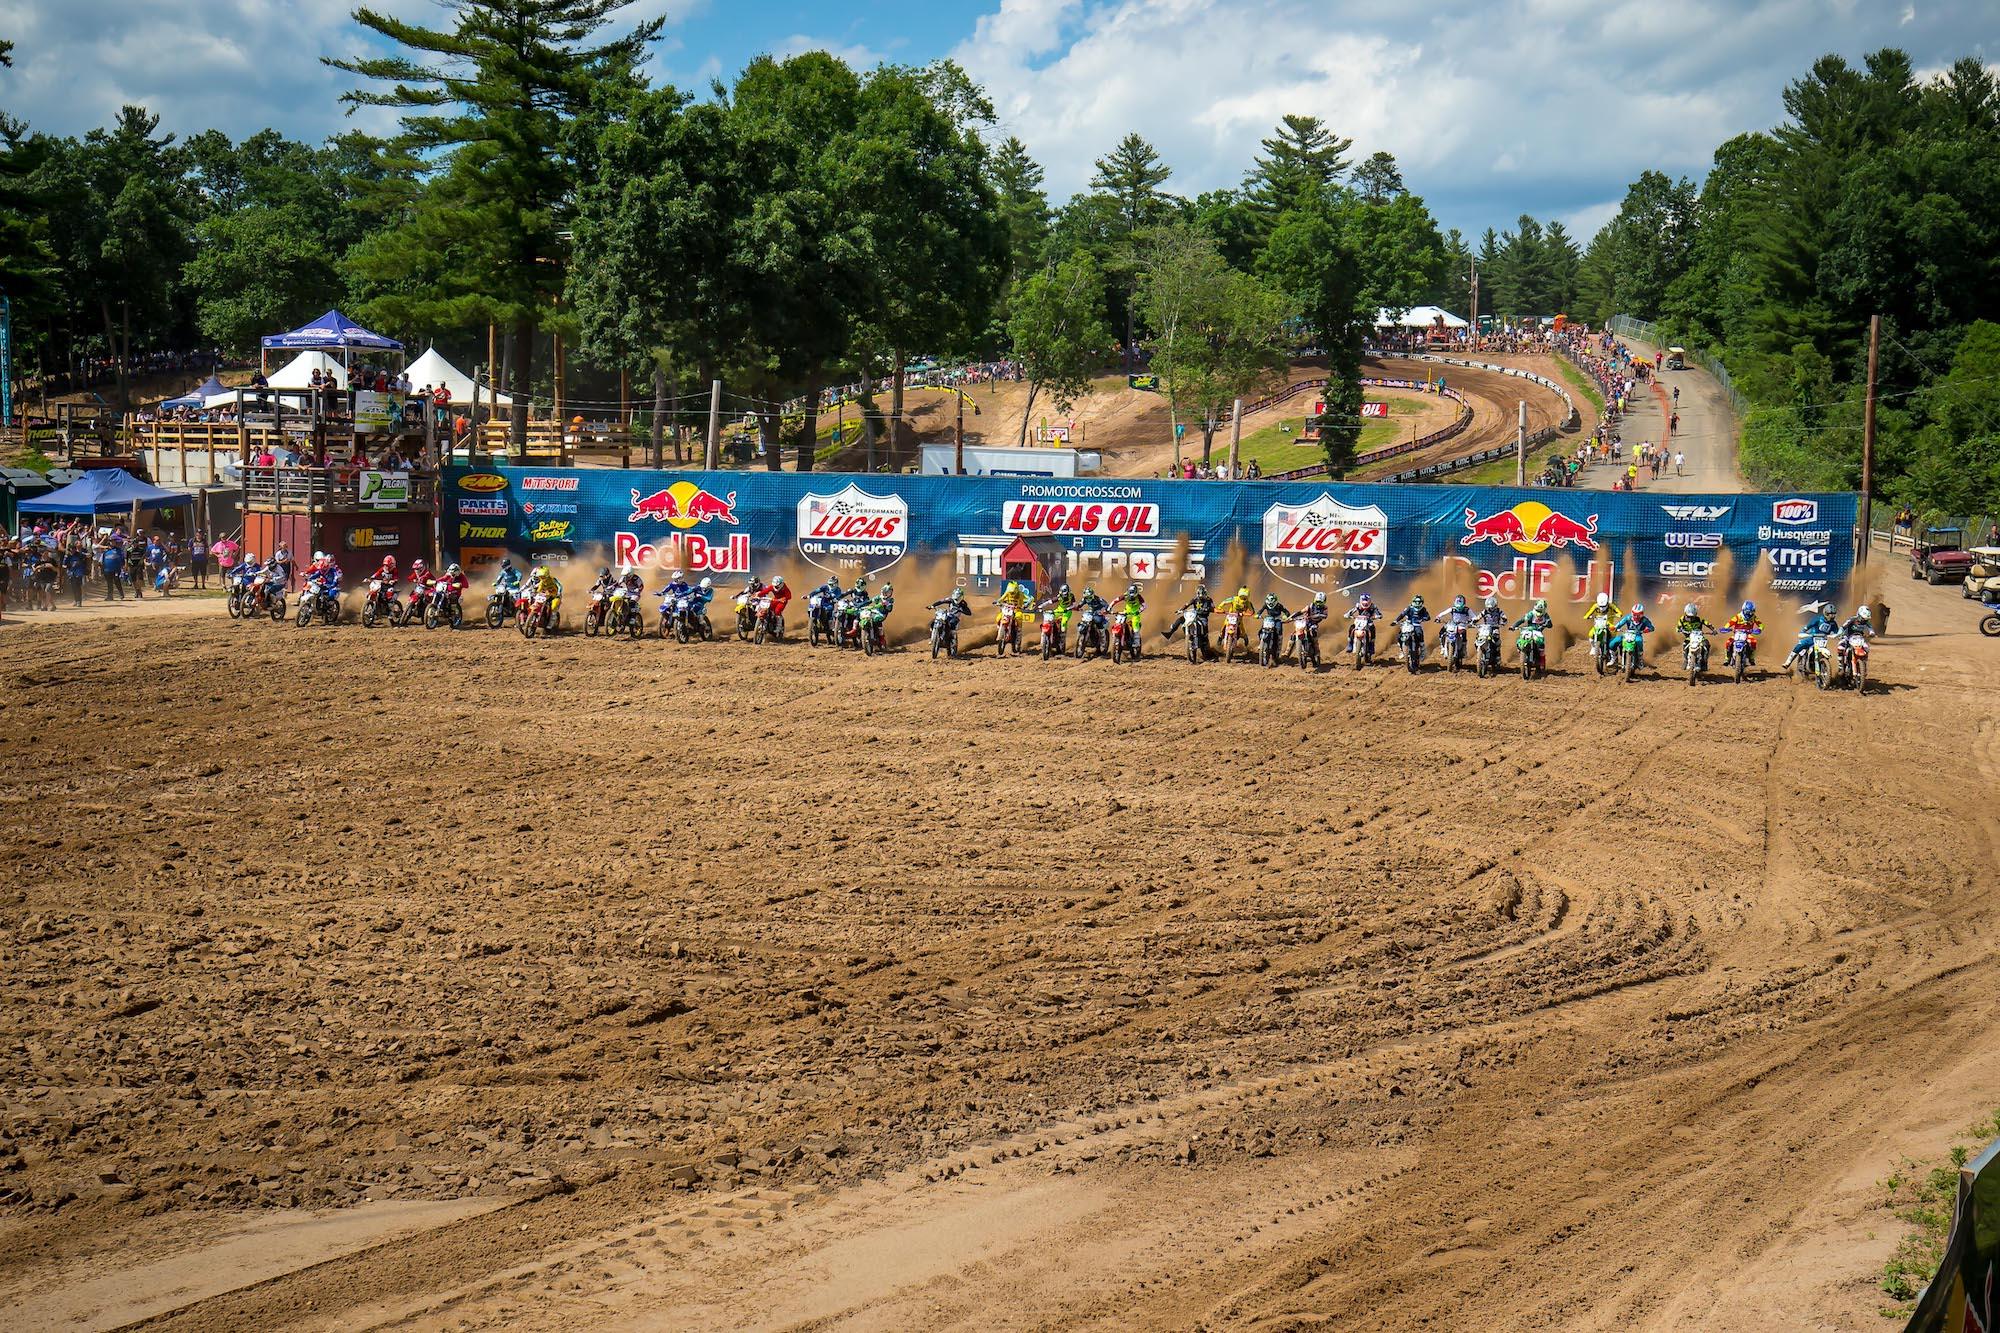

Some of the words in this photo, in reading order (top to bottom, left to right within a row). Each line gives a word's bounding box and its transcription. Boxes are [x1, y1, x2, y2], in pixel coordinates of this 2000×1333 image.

[1361, 404, 1381, 417] OIL
[1022, 486, 1141, 498] PROMOTOCROSS.COM
[460, 500, 507, 508] PARTS
[1778, 504, 1811, 519] 100%
[1010, 503, 1102, 531] LUCAS
[1108, 505, 1153, 533] OIL
[470, 527, 507, 538] THOR
[810, 514, 901, 539] LUCAS
[354, 528, 374, 547] MB
[1277, 527, 1380, 552] LUCAS
[1666, 533, 1722, 548] WPS
[1772, 529, 1831, 541] Husqvarna
[532, 552, 569, 561] GoPro
[615, 532, 681, 571] Red
[685, 534, 750, 572] Bull
[803, 543, 826, 553] OIL
[830, 544, 901, 556] PRODUCTS
[1269, 556, 1295, 567] OIL
[1300, 557, 1380, 571] PRODUCTS
